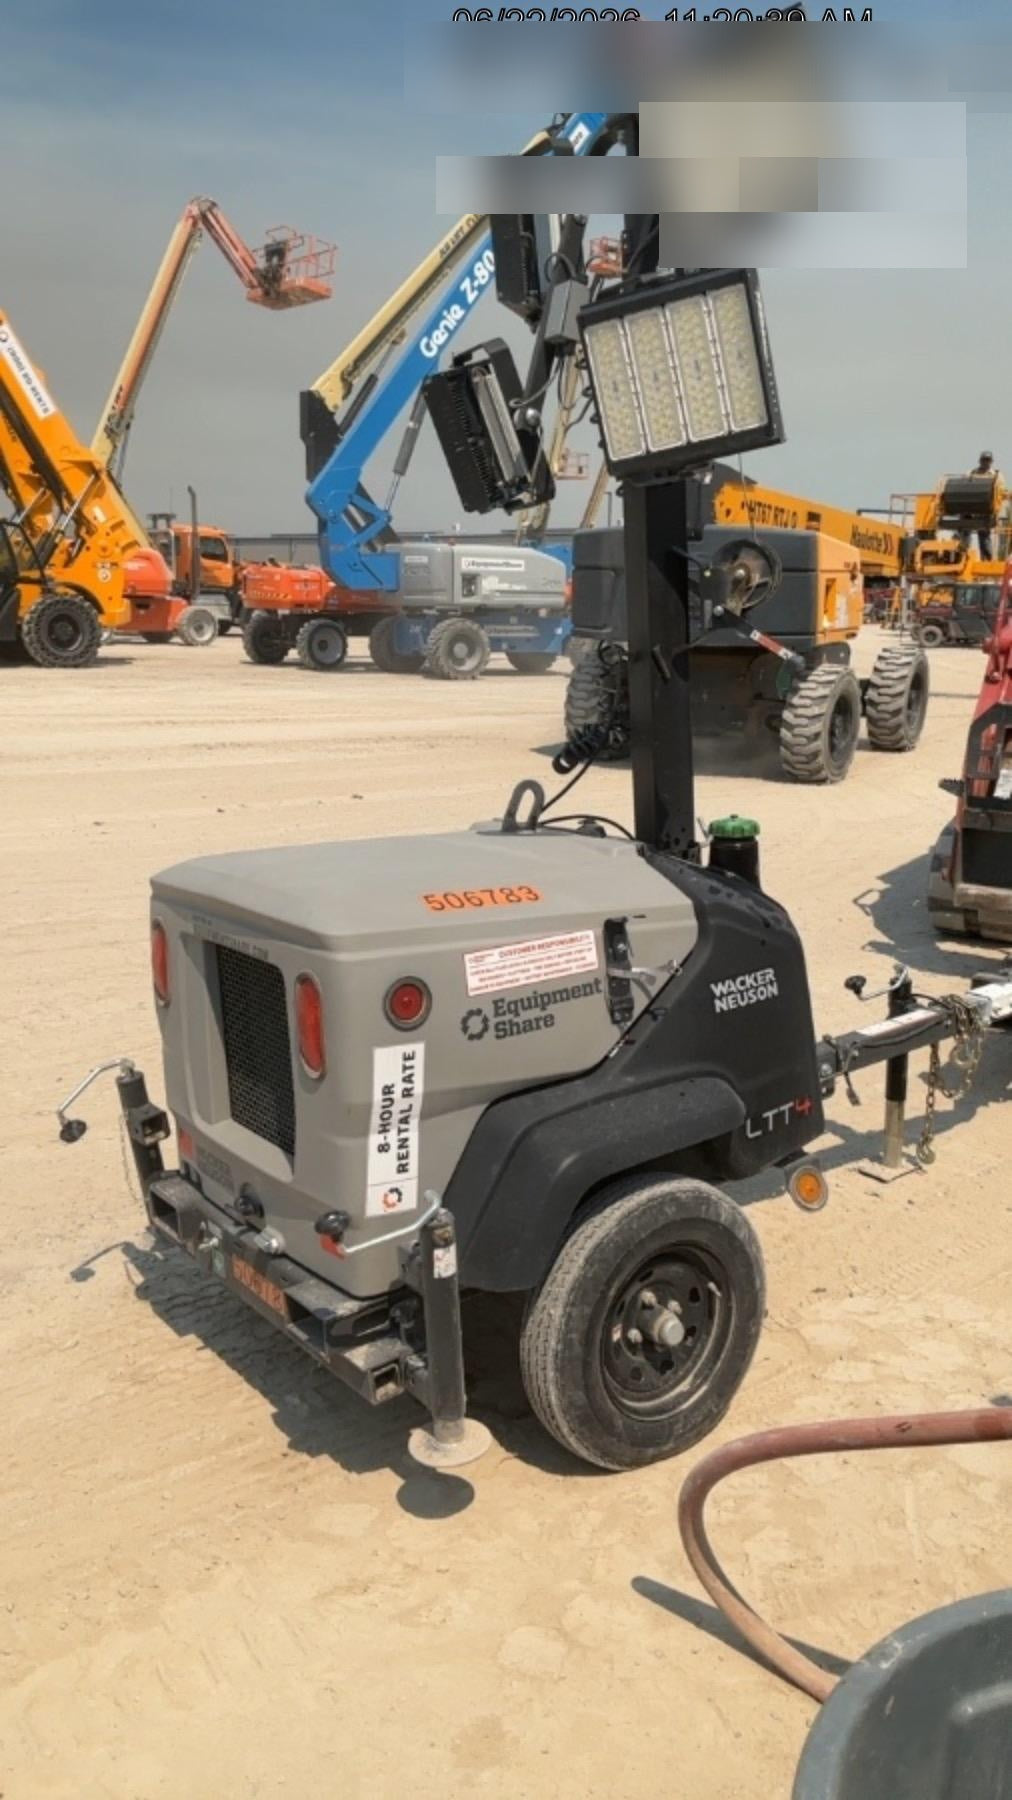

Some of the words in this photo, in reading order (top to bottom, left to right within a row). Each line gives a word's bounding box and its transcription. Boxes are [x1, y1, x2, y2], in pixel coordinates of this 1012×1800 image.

[419, 304, 466, 358] Genie
[459, 248, 496, 305] Z-80
[423, 885, 540, 911] 506783
[492, 977, 602, 1018] Equipment
[710, 968, 776, 997] WACKER
[714, 982, 778, 1013] NEUSON
[493, 1012, 555, 1040] Share
[402, 1049, 416, 1099] RATE
[377, 1083, 395, 1154] 8-HOUR
[396, 1103, 413, 1174] RENTAL
[745, 1096, 812, 1139] LTT4
